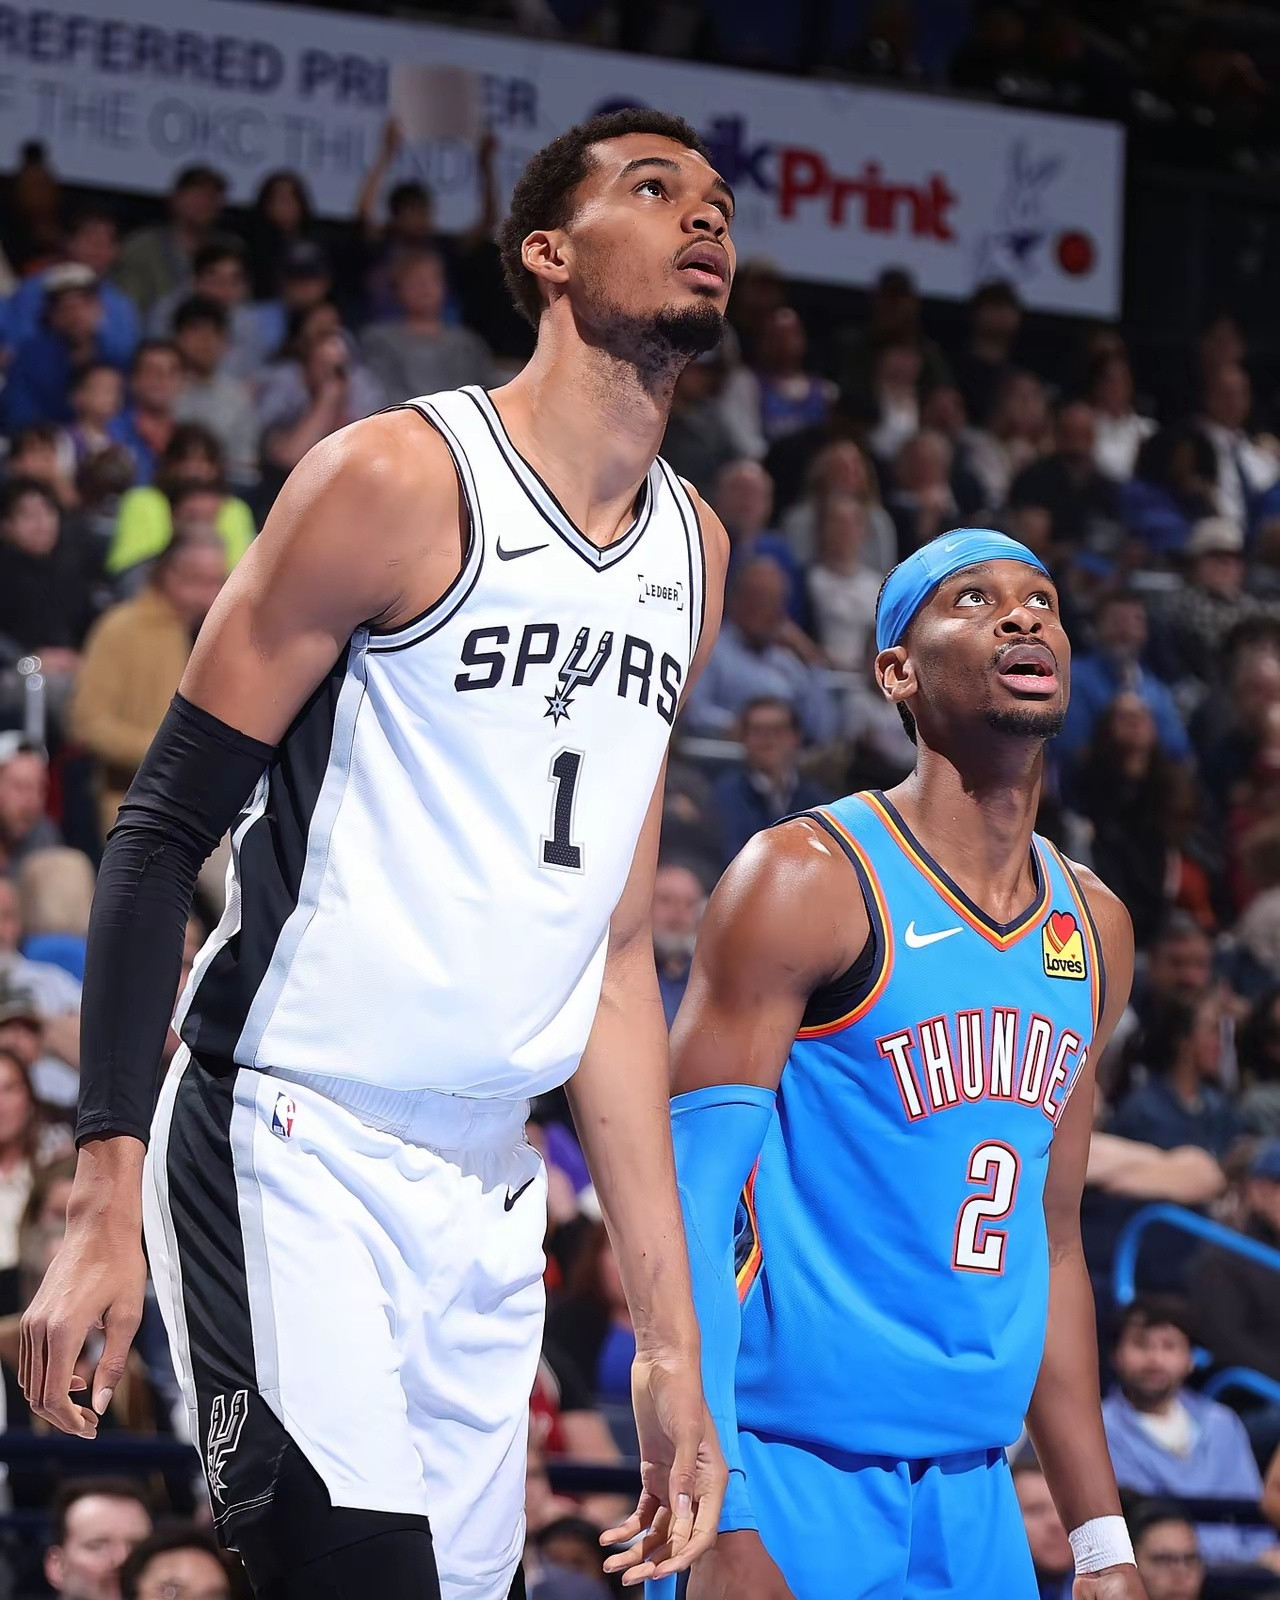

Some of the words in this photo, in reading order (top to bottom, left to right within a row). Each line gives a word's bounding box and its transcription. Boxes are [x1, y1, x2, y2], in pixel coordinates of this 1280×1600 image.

[299, 47, 540, 130] PRIER
[645, 583, 679, 601] LEDGER
[454, 623, 682, 727] SPURS
[538, 746, 585, 875] 1
[951, 1139, 1021, 1276] 2
